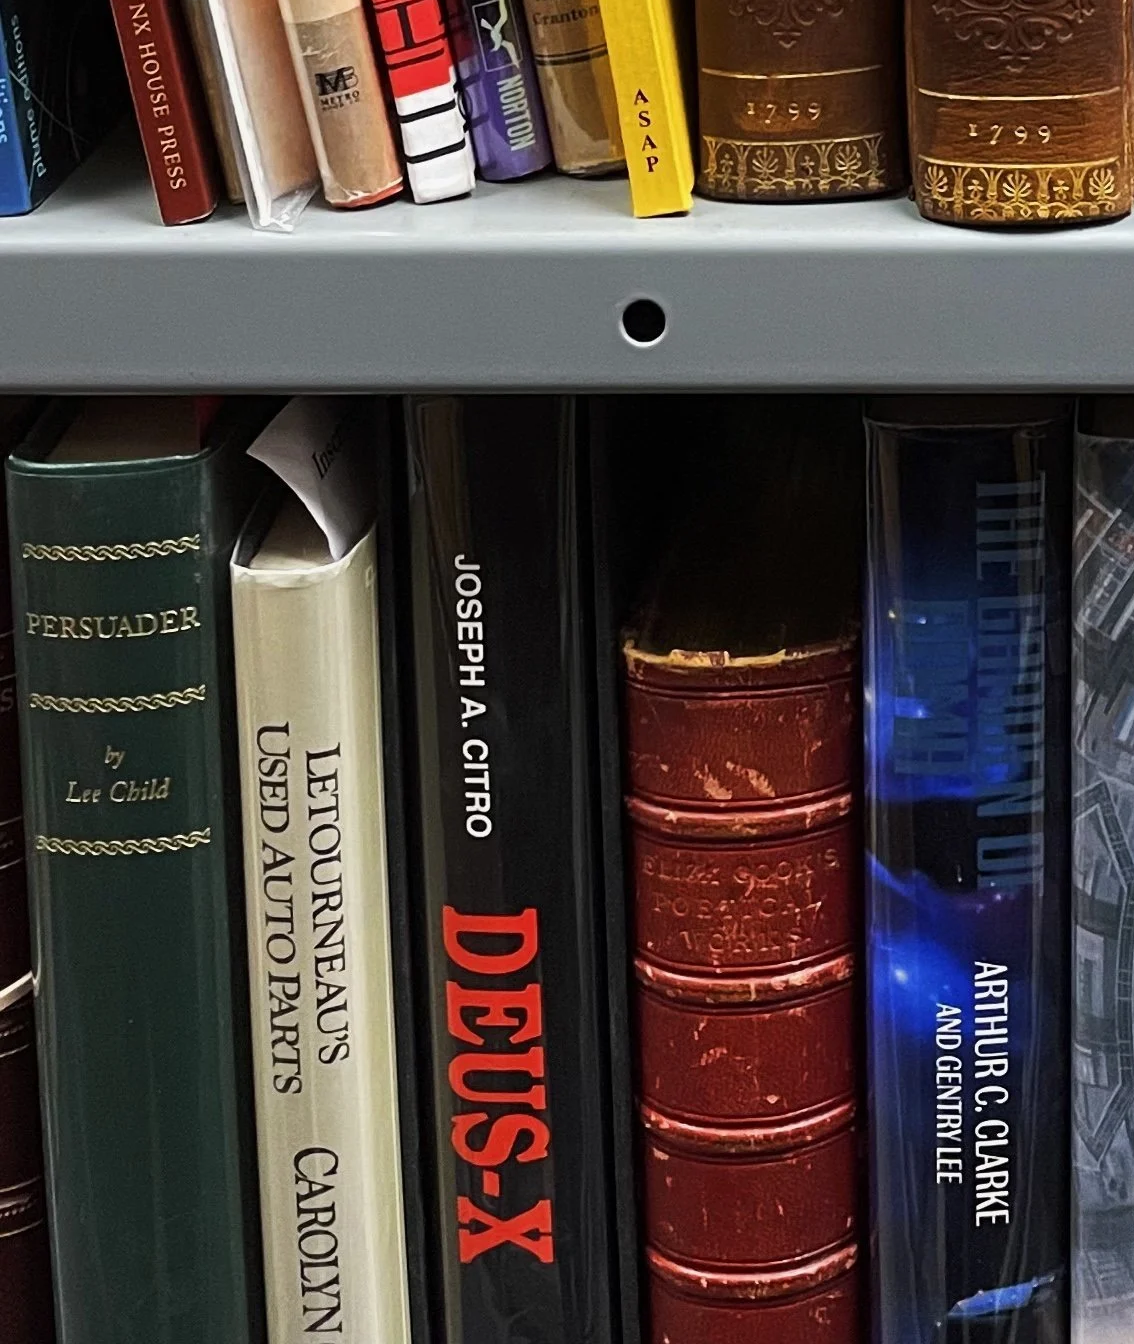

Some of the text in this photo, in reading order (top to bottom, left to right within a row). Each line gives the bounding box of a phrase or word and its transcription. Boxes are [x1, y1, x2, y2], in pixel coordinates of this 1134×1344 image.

[140, 44, 169, 118] HOUSE
[158, 124, 186, 190] PRESS
[634, 89, 659, 172] ASAP
[968, 123, 1053, 145] 1799
[26, 606, 201, 640] PERSUADER
[455, 553, 492, 839] JOSEPH A. CITRO
[66, 777, 170, 803] Lee Child
[256, 722, 303, 1095] USED AUTO PARTS
[306, 743, 350, 1065] LETOURNEAU'S
[443, 906, 554, 1263] DEUS-X
[935, 1003, 962, 1184] AND GENTRY LEE
[974, 960, 1009, 1226] ARTHUR C. CLARKE
[294, 1146, 342, 1333] CAROLYN
